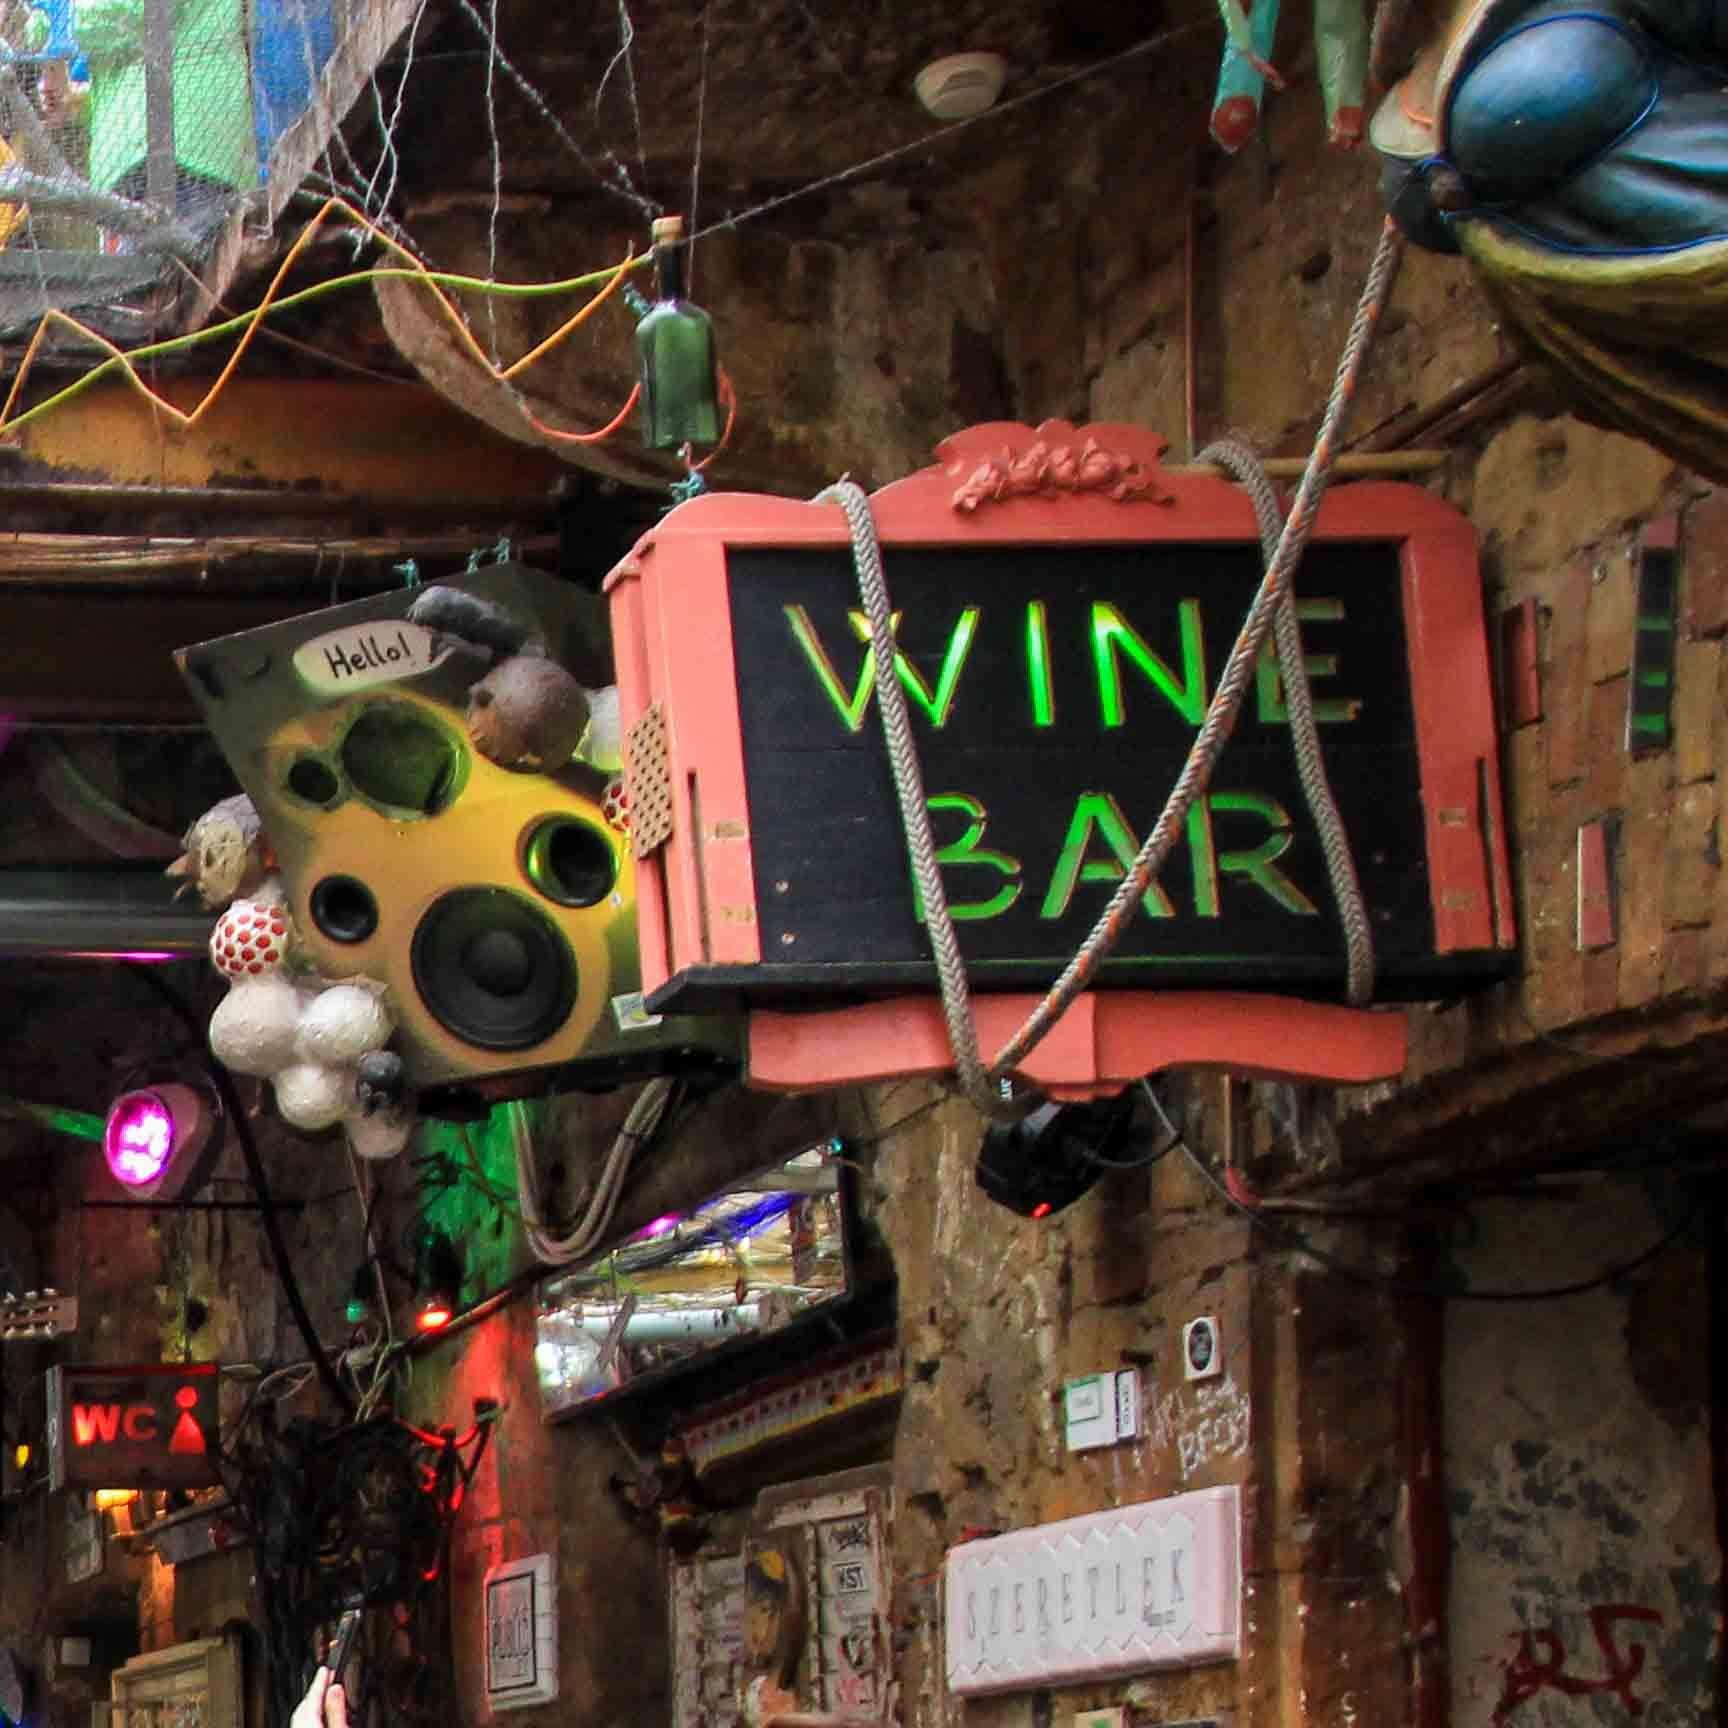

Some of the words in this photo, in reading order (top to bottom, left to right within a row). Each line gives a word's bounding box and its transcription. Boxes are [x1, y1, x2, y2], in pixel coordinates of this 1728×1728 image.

[324, 631, 417, 678] Hello!
[784, 598, 1362, 733] WINE
[912, 791, 1318, 924] BAR
[70, 1402, 158, 1447] WC
